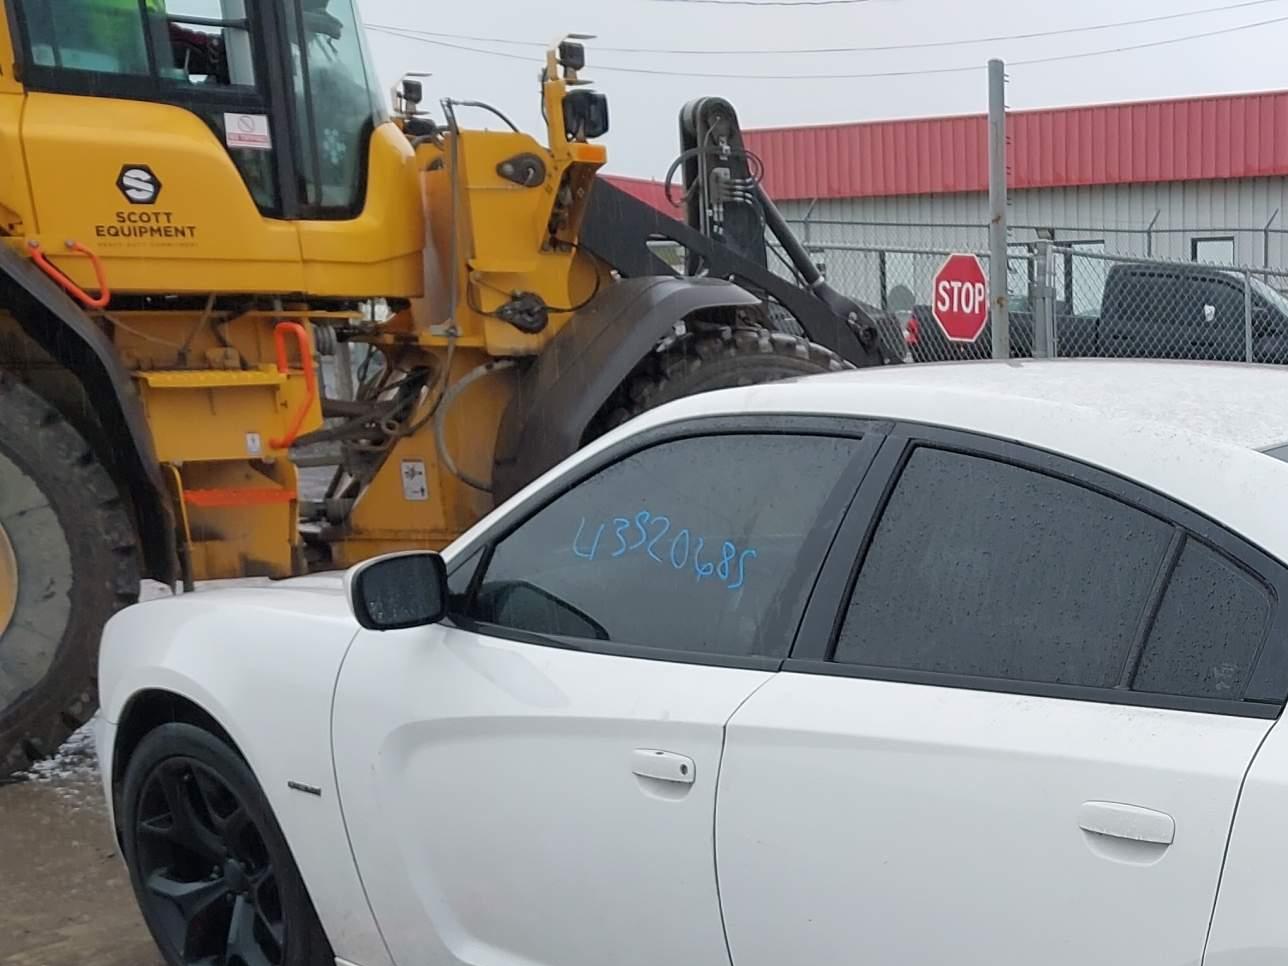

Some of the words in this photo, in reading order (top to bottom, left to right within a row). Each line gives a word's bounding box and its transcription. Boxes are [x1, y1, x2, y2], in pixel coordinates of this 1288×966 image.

[115, 211, 173, 224] SCOTT
[95, 225, 197, 238] EQUIPMENT
[937, 280, 985, 314] STOP
[572, 510, 758, 589] 43520685
